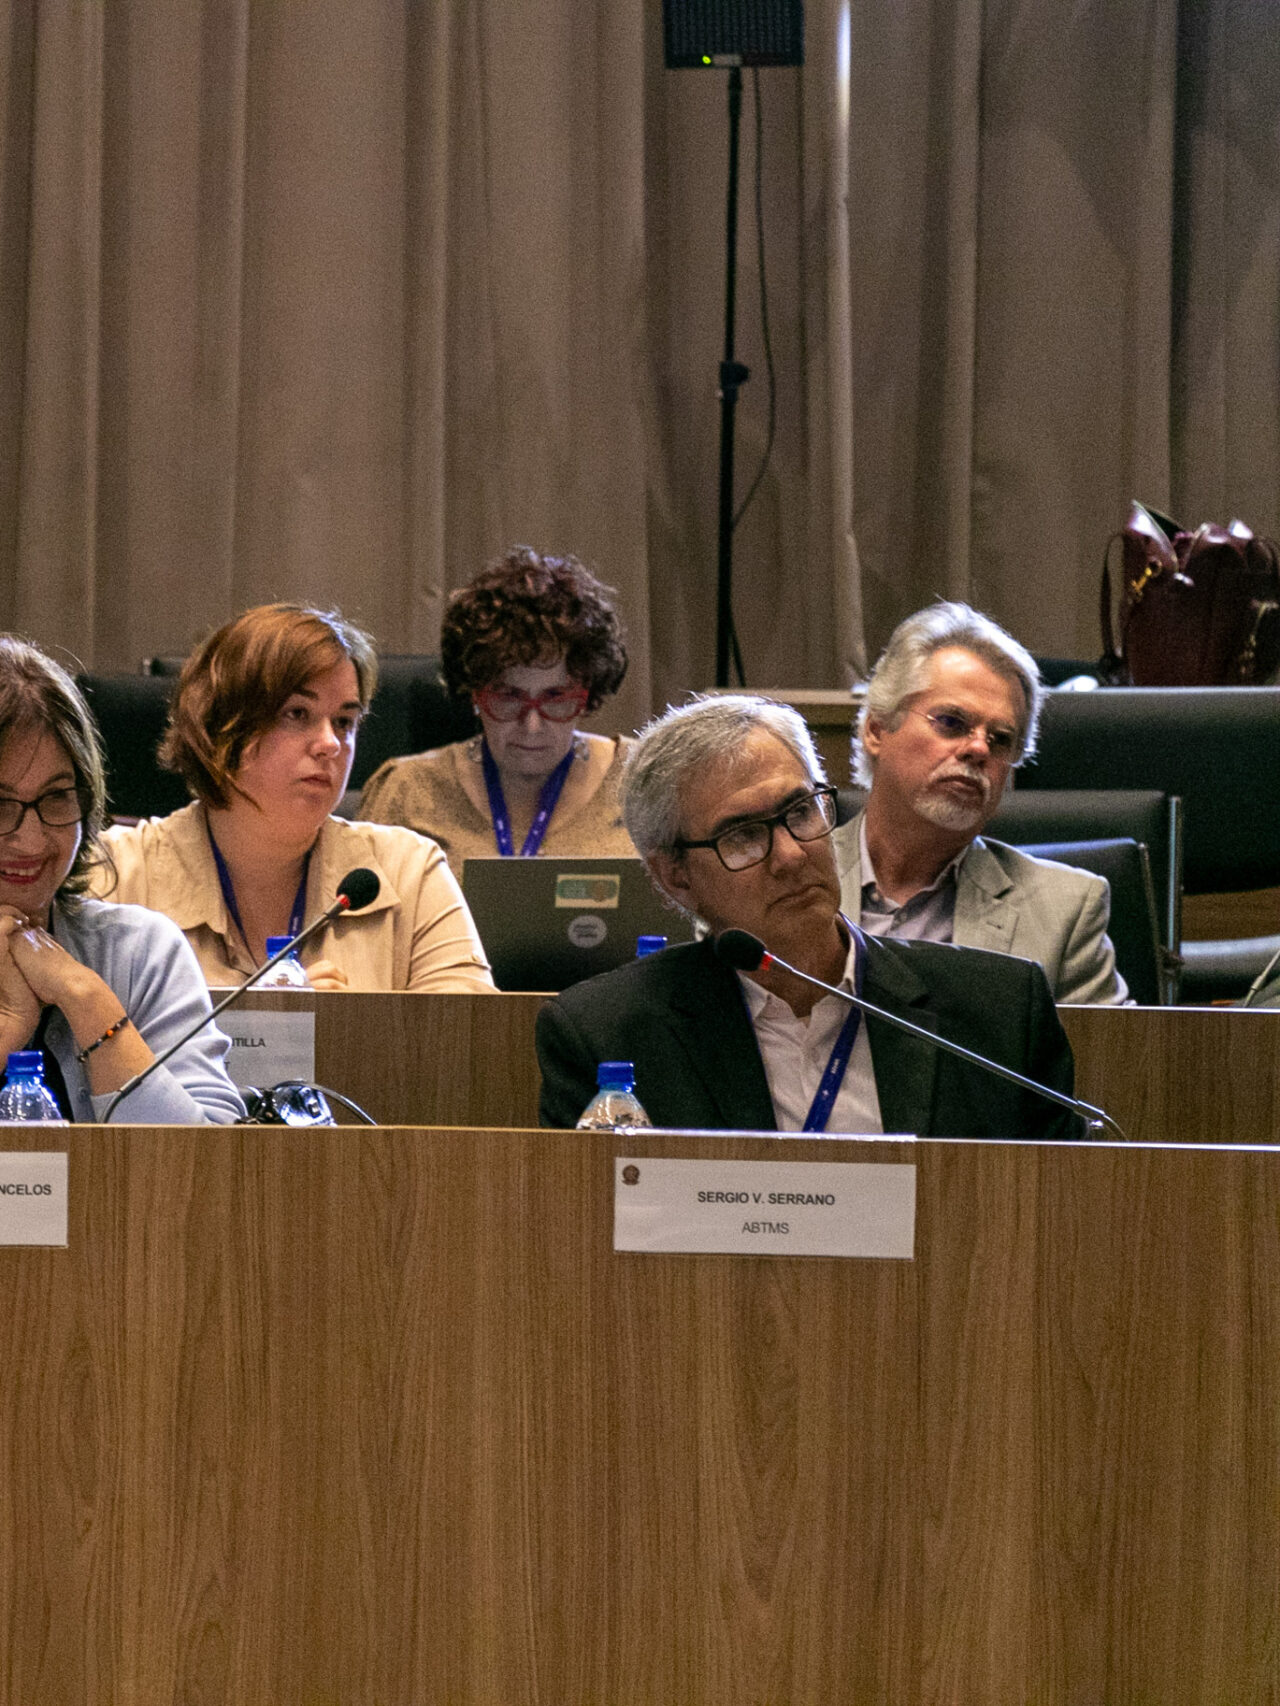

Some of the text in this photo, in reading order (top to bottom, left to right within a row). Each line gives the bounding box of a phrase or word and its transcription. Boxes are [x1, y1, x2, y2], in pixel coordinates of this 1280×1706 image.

[697, 1191, 836, 1206] SERGIO V. SERRANO
[741, 1221, 790, 1235] ABTMS
